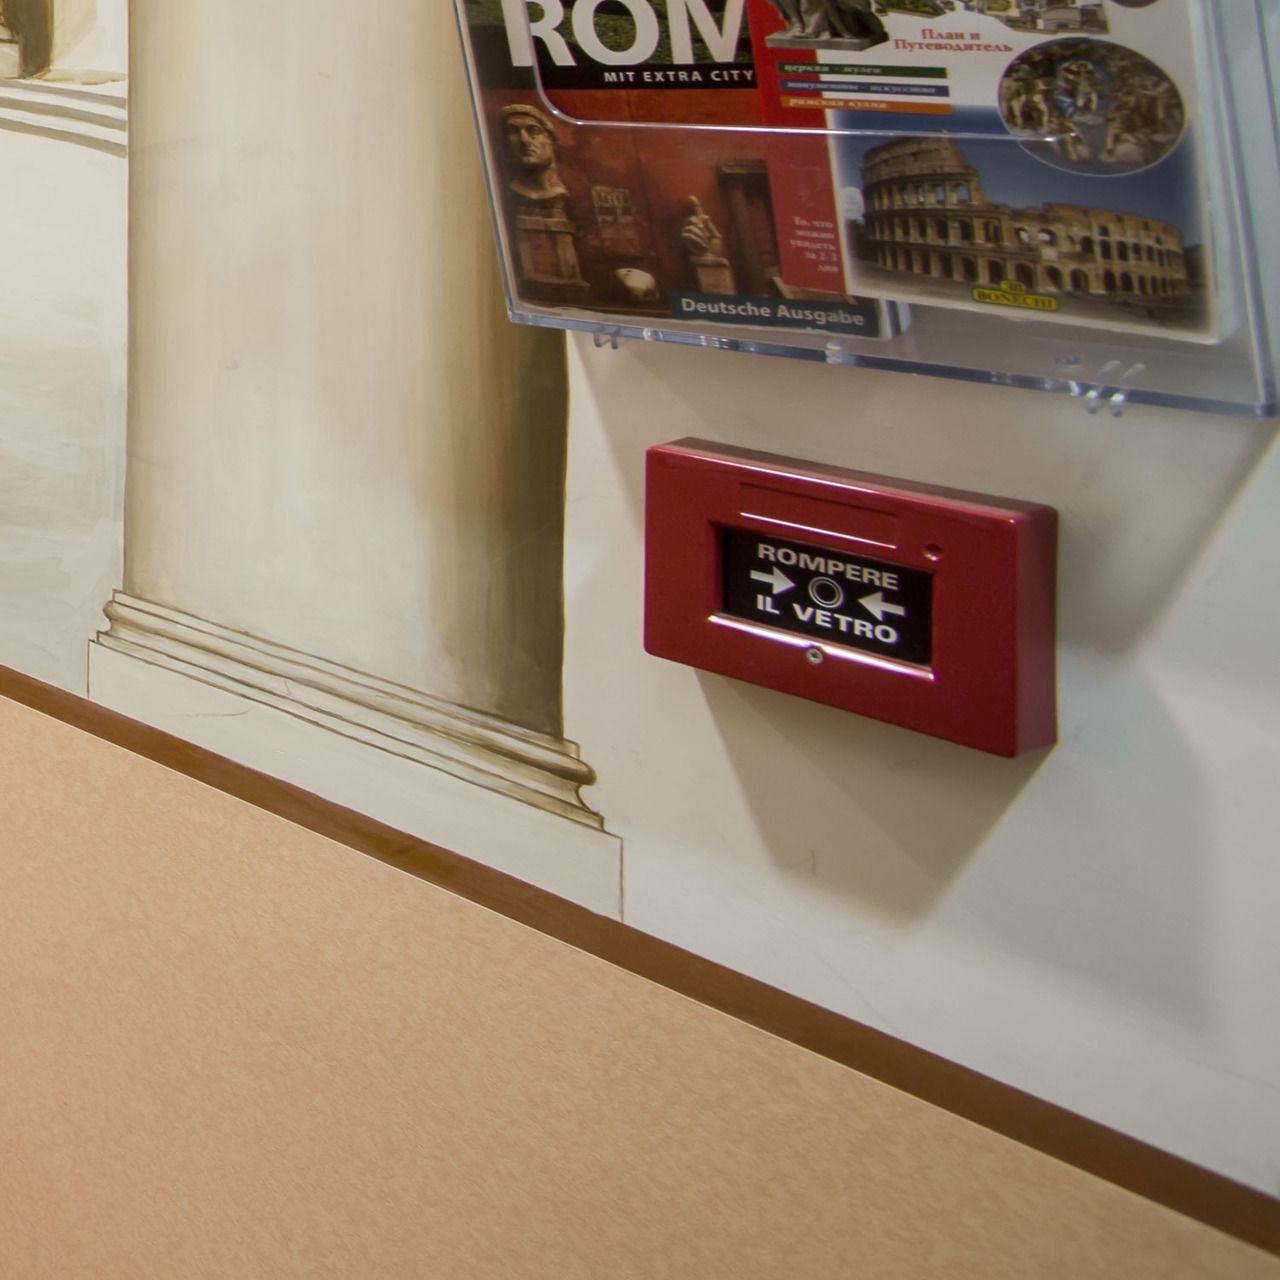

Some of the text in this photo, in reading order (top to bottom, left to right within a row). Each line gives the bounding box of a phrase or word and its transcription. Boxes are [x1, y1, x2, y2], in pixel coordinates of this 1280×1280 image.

[921, 28, 981, 41] План и
[894, 39, 1014, 53] Путеводитель
[604, 69, 754, 83] MIT EXTRA CITY
[681, 298, 865, 327] Deutsche Ausgabe
[757, 543, 900, 590] ROMPERE
[756, 595, 899, 645] IL VETRO
